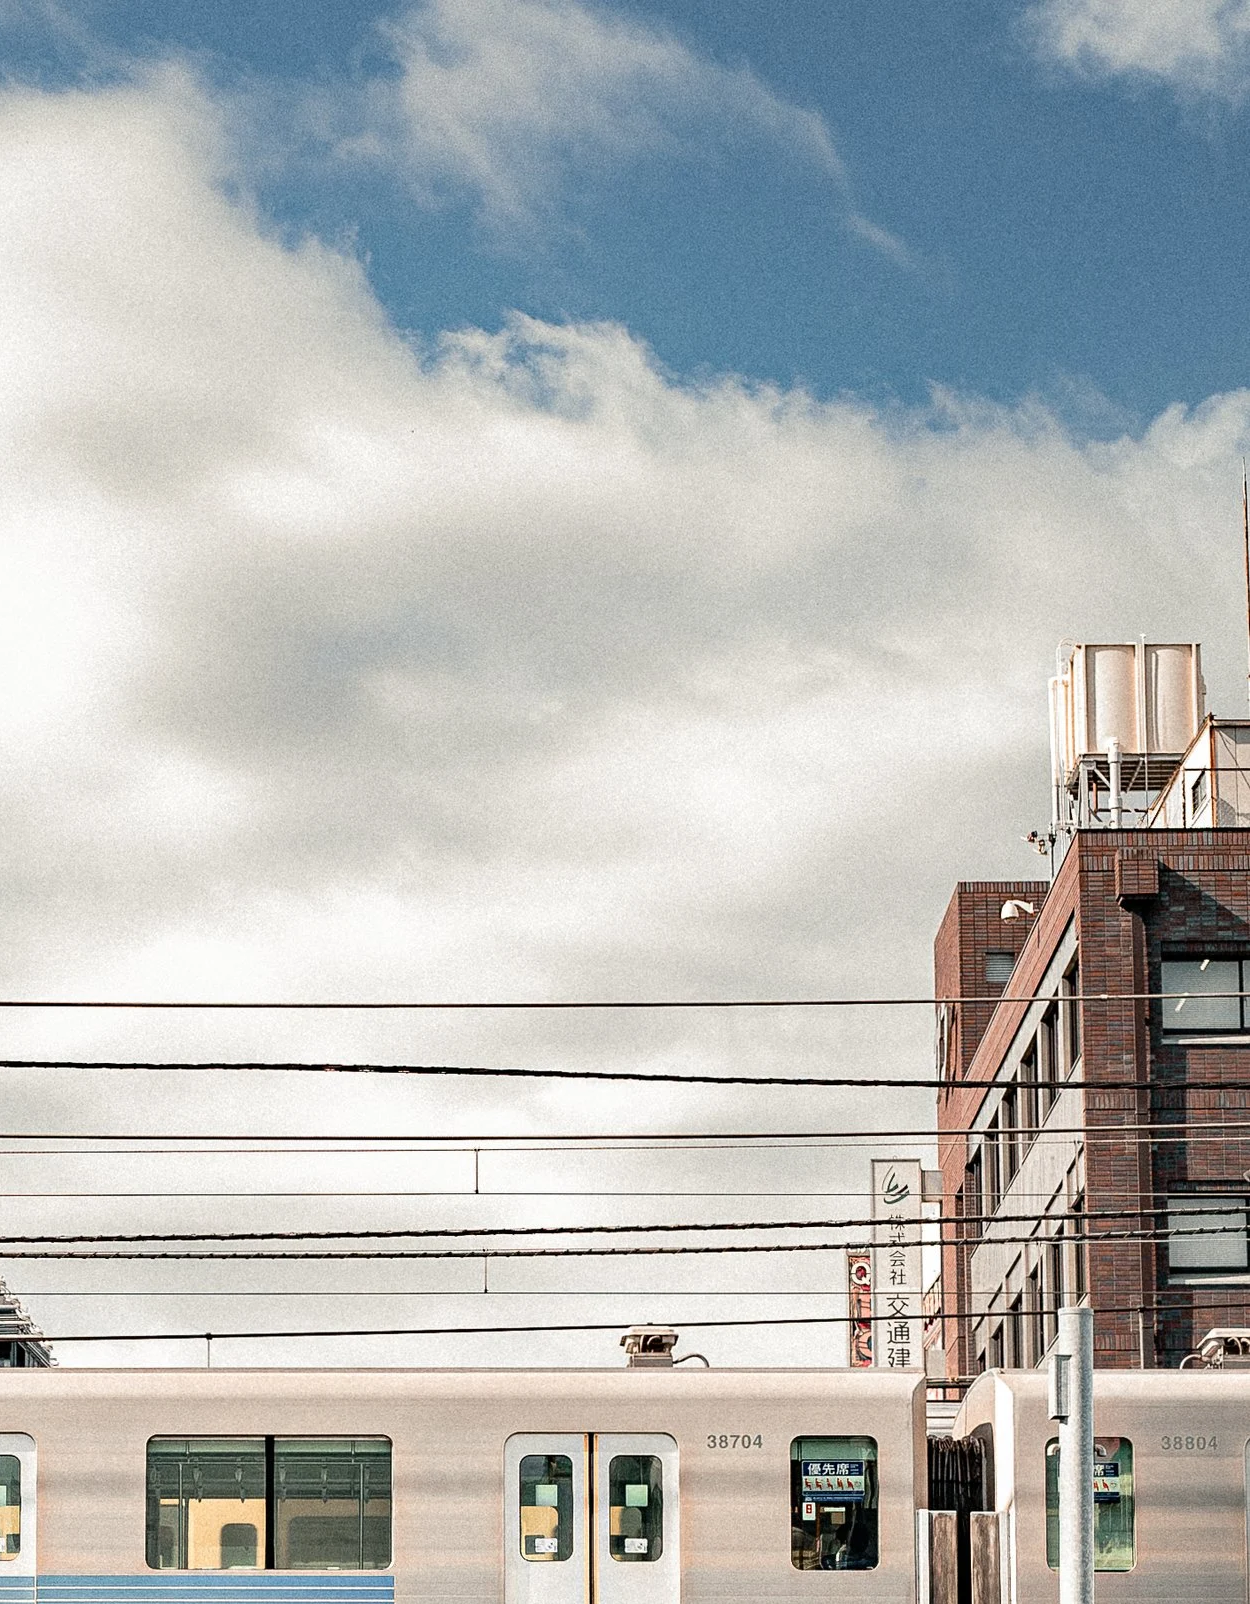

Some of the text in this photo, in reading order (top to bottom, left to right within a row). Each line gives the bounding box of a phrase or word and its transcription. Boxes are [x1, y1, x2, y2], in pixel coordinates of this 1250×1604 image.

[707, 1434, 763, 1449] 38704
[1161, 1435, 1218, 1450] 38804
[807, 1463, 849, 1476] 優先席
